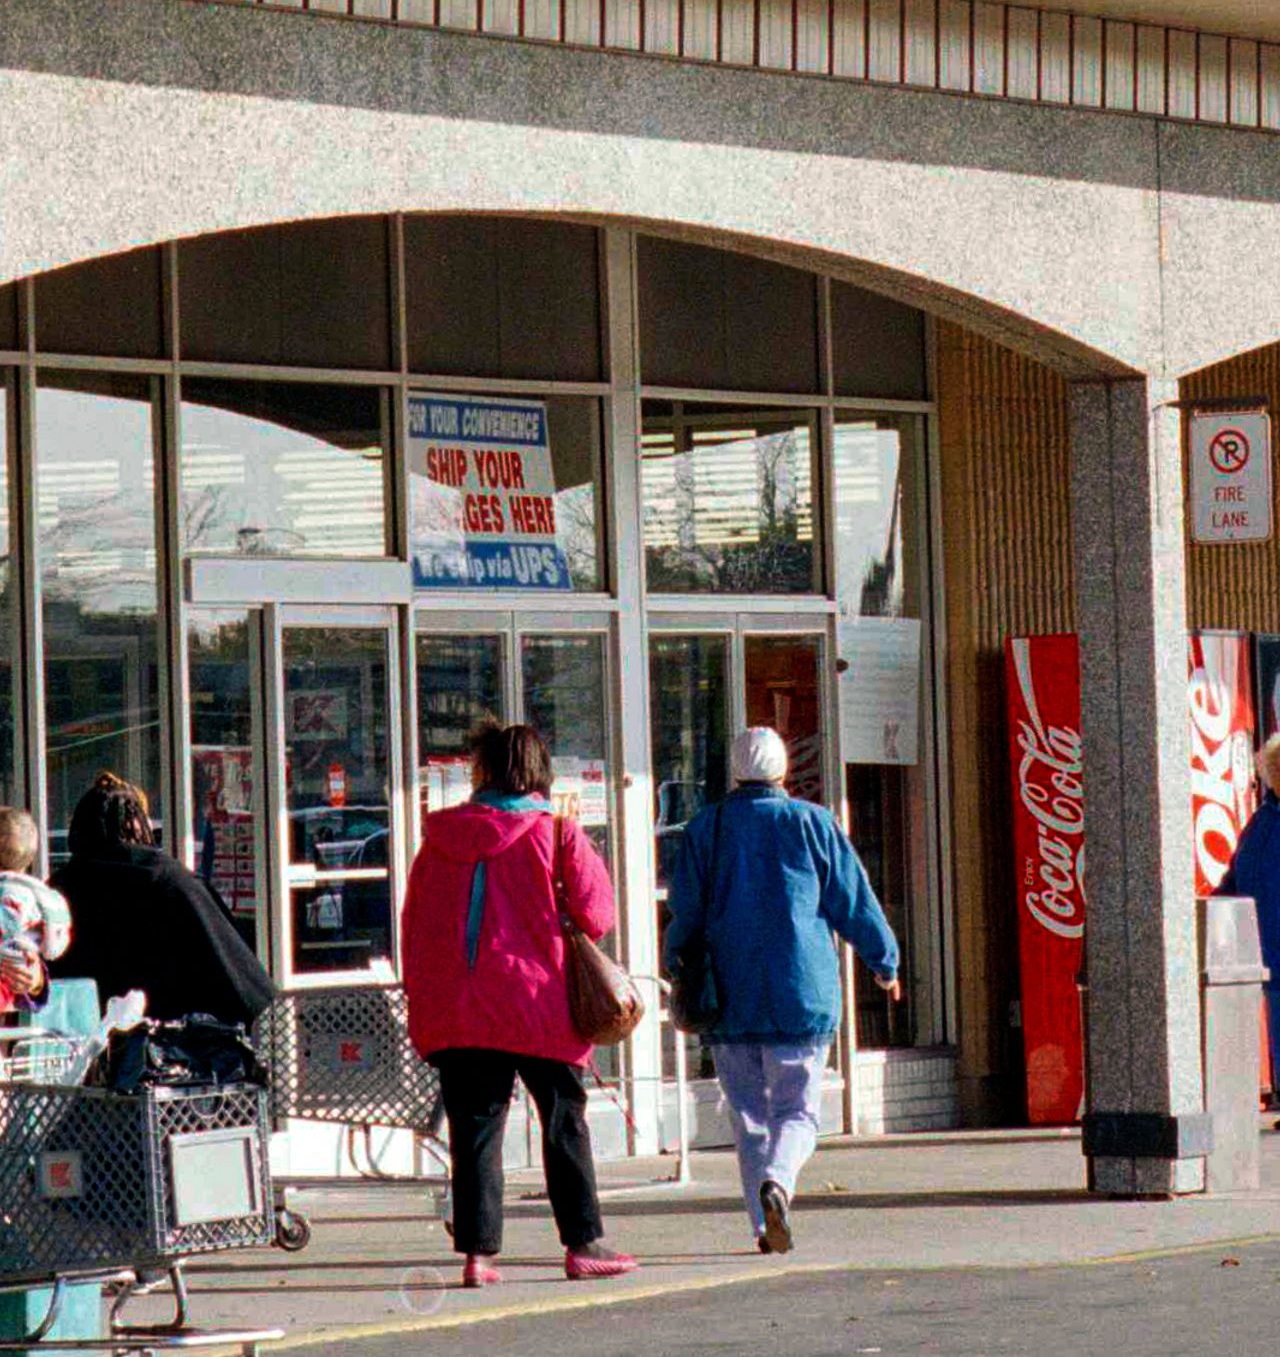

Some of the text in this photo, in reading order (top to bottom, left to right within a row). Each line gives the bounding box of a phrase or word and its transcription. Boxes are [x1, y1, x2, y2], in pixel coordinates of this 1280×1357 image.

[429, 405, 458, 435] YOUR
[462, 408, 540, 440] CONVENIENCE
[426, 447, 525, 490] SHIP YOUR
[1213, 485, 1248, 503] FIRE
[1211, 511, 1249, 529] LANE
[510, 547, 560, 585] UPS
